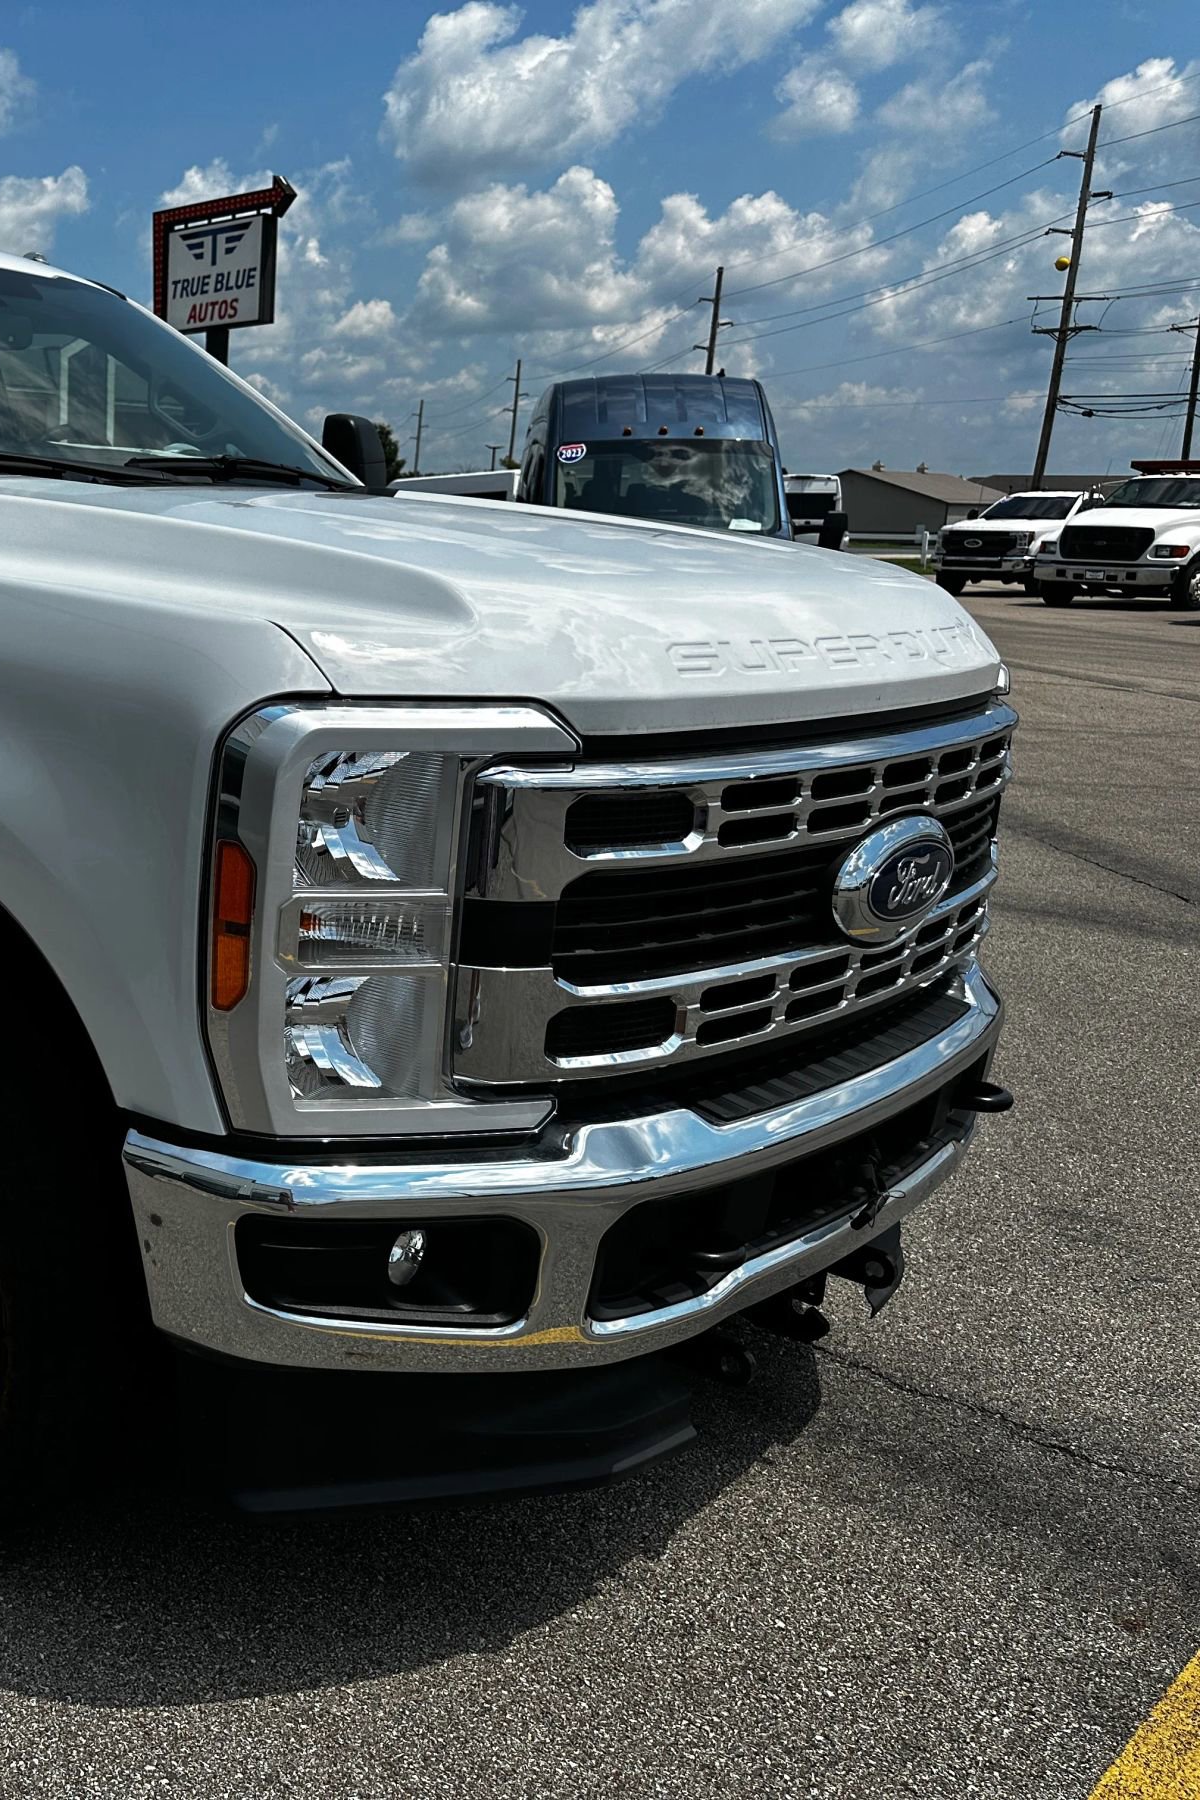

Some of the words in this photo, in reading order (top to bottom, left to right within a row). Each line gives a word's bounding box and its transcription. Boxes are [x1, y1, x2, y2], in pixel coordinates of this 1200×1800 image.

[171, 275, 211, 300] TRUE
[213, 267, 257, 293] BLUE
[187, 298, 239, 324] AUTOS
[561, 449, 582, 459] 2023
[887, 853, 941, 910] Ford
